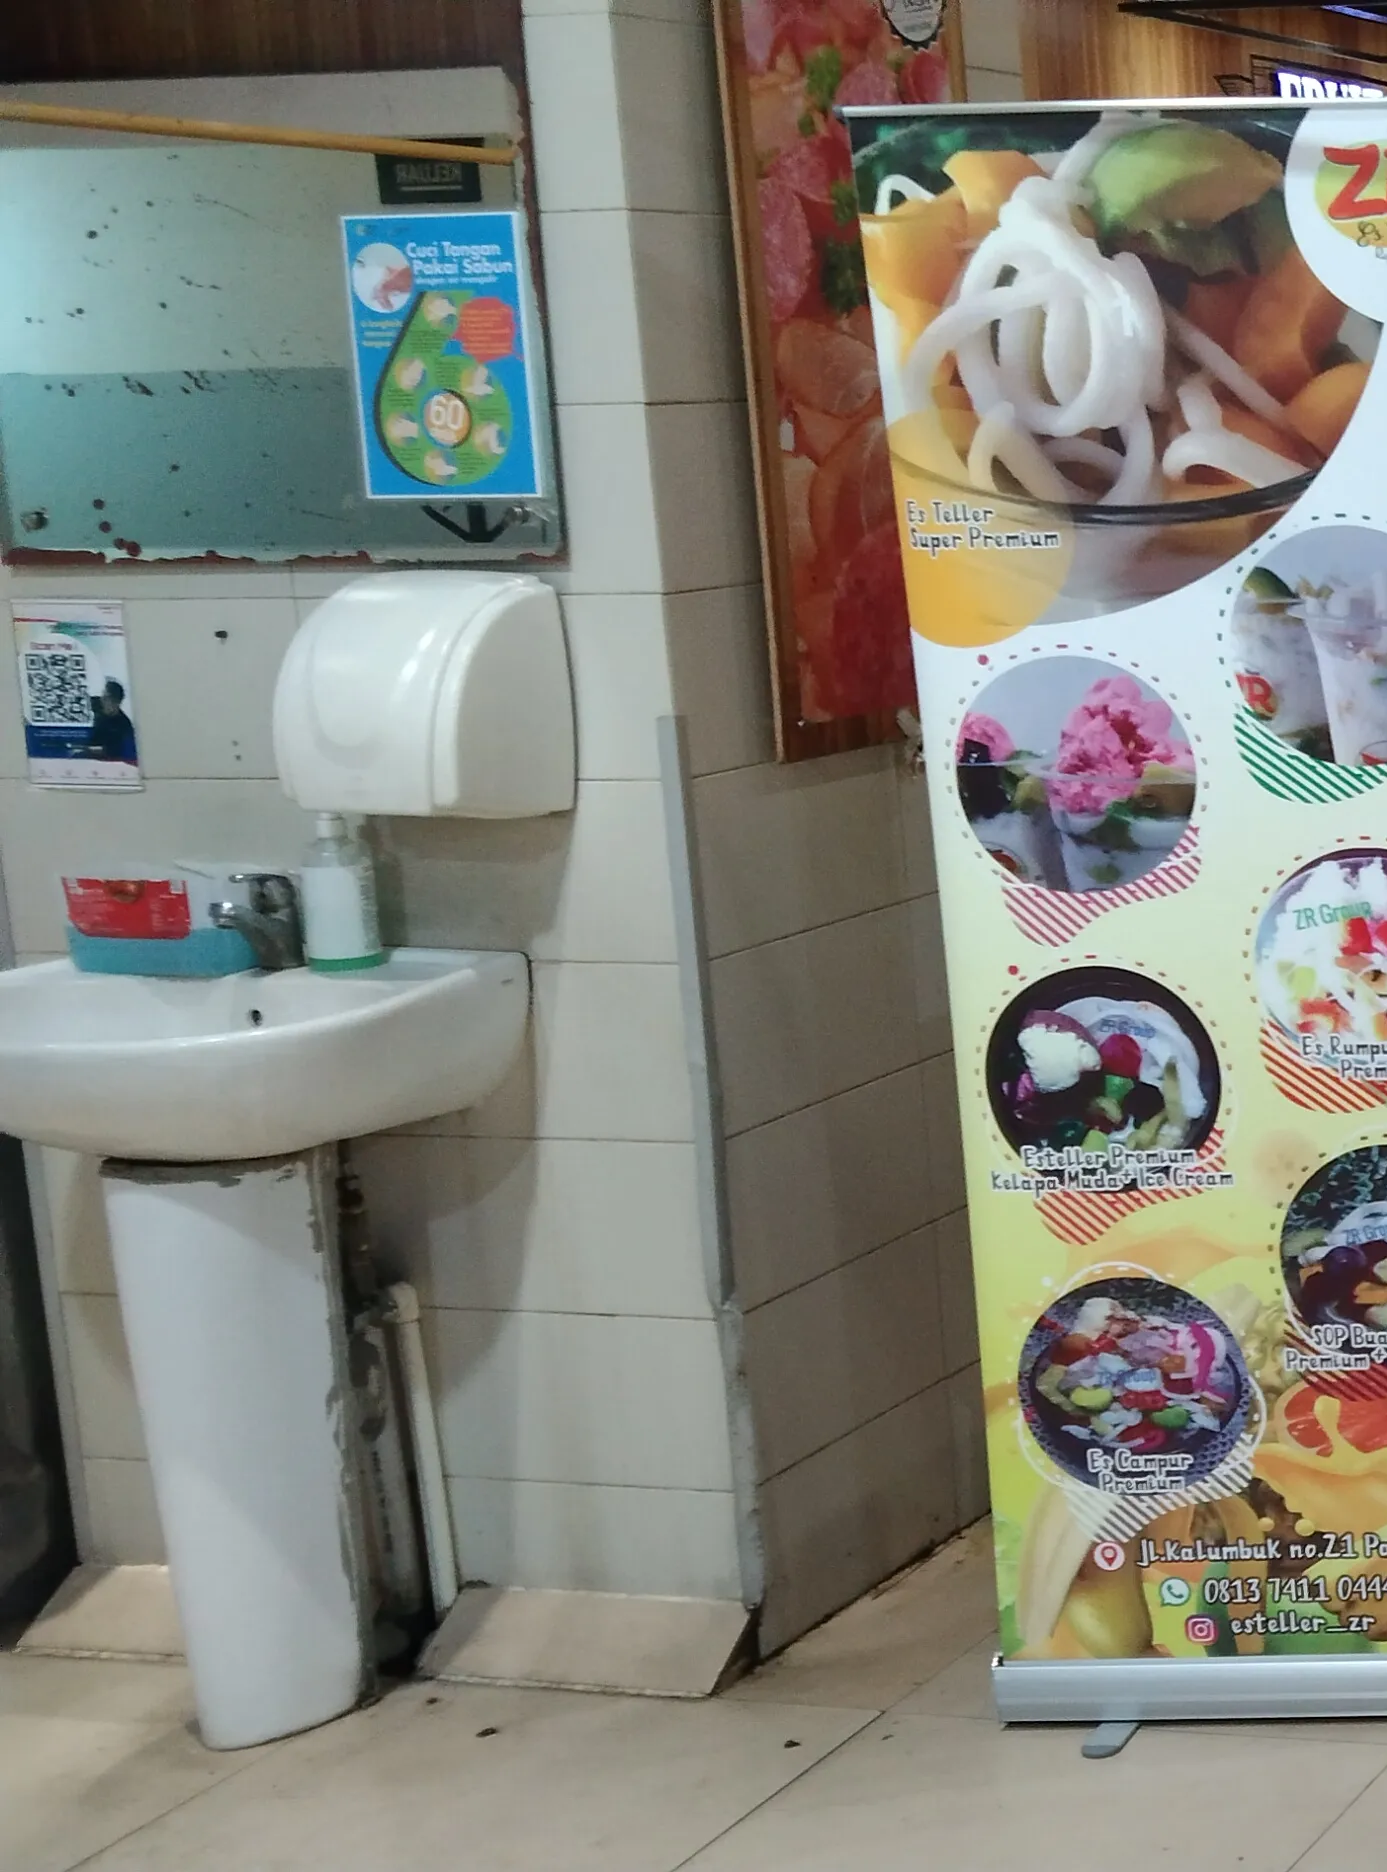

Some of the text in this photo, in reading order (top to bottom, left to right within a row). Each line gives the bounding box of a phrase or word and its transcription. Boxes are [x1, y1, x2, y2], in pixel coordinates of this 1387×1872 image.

[1355, 220, 1382, 248] Es
[405, 241, 502, 261] Cuci Tangan
[412, 258, 513, 275] Pakai Sabun
[430, 393, 466, 430] 60
[907, 500, 994, 523] Es Teller
[910, 526, 1060, 557] Super Premium
[1293, 908, 1319, 931] ZR
[1301, 1036, 1324, 1056] Es
[1023, 1146, 1195, 1168] Esteller Premium
[991, 1172, 1058, 1197] Kelapa
[1140, 1171, 1166, 1188] Ice
[1173, 1169, 1234, 1187] Cream
[1344, 1229, 1361, 1246] ZR
[1313, 1326, 1346, 1346] SOP
[1286, 1353, 1367, 1370] Premium
[1088, 1449, 1192, 1476] Es Campur
[1101, 1474, 1185, 1492] Premium
[1204, 1578, 1261, 1604] 0813
[1267, 1577, 1331, 1604] 7411
[1231, 1612, 1376, 1634] esteller_zr
